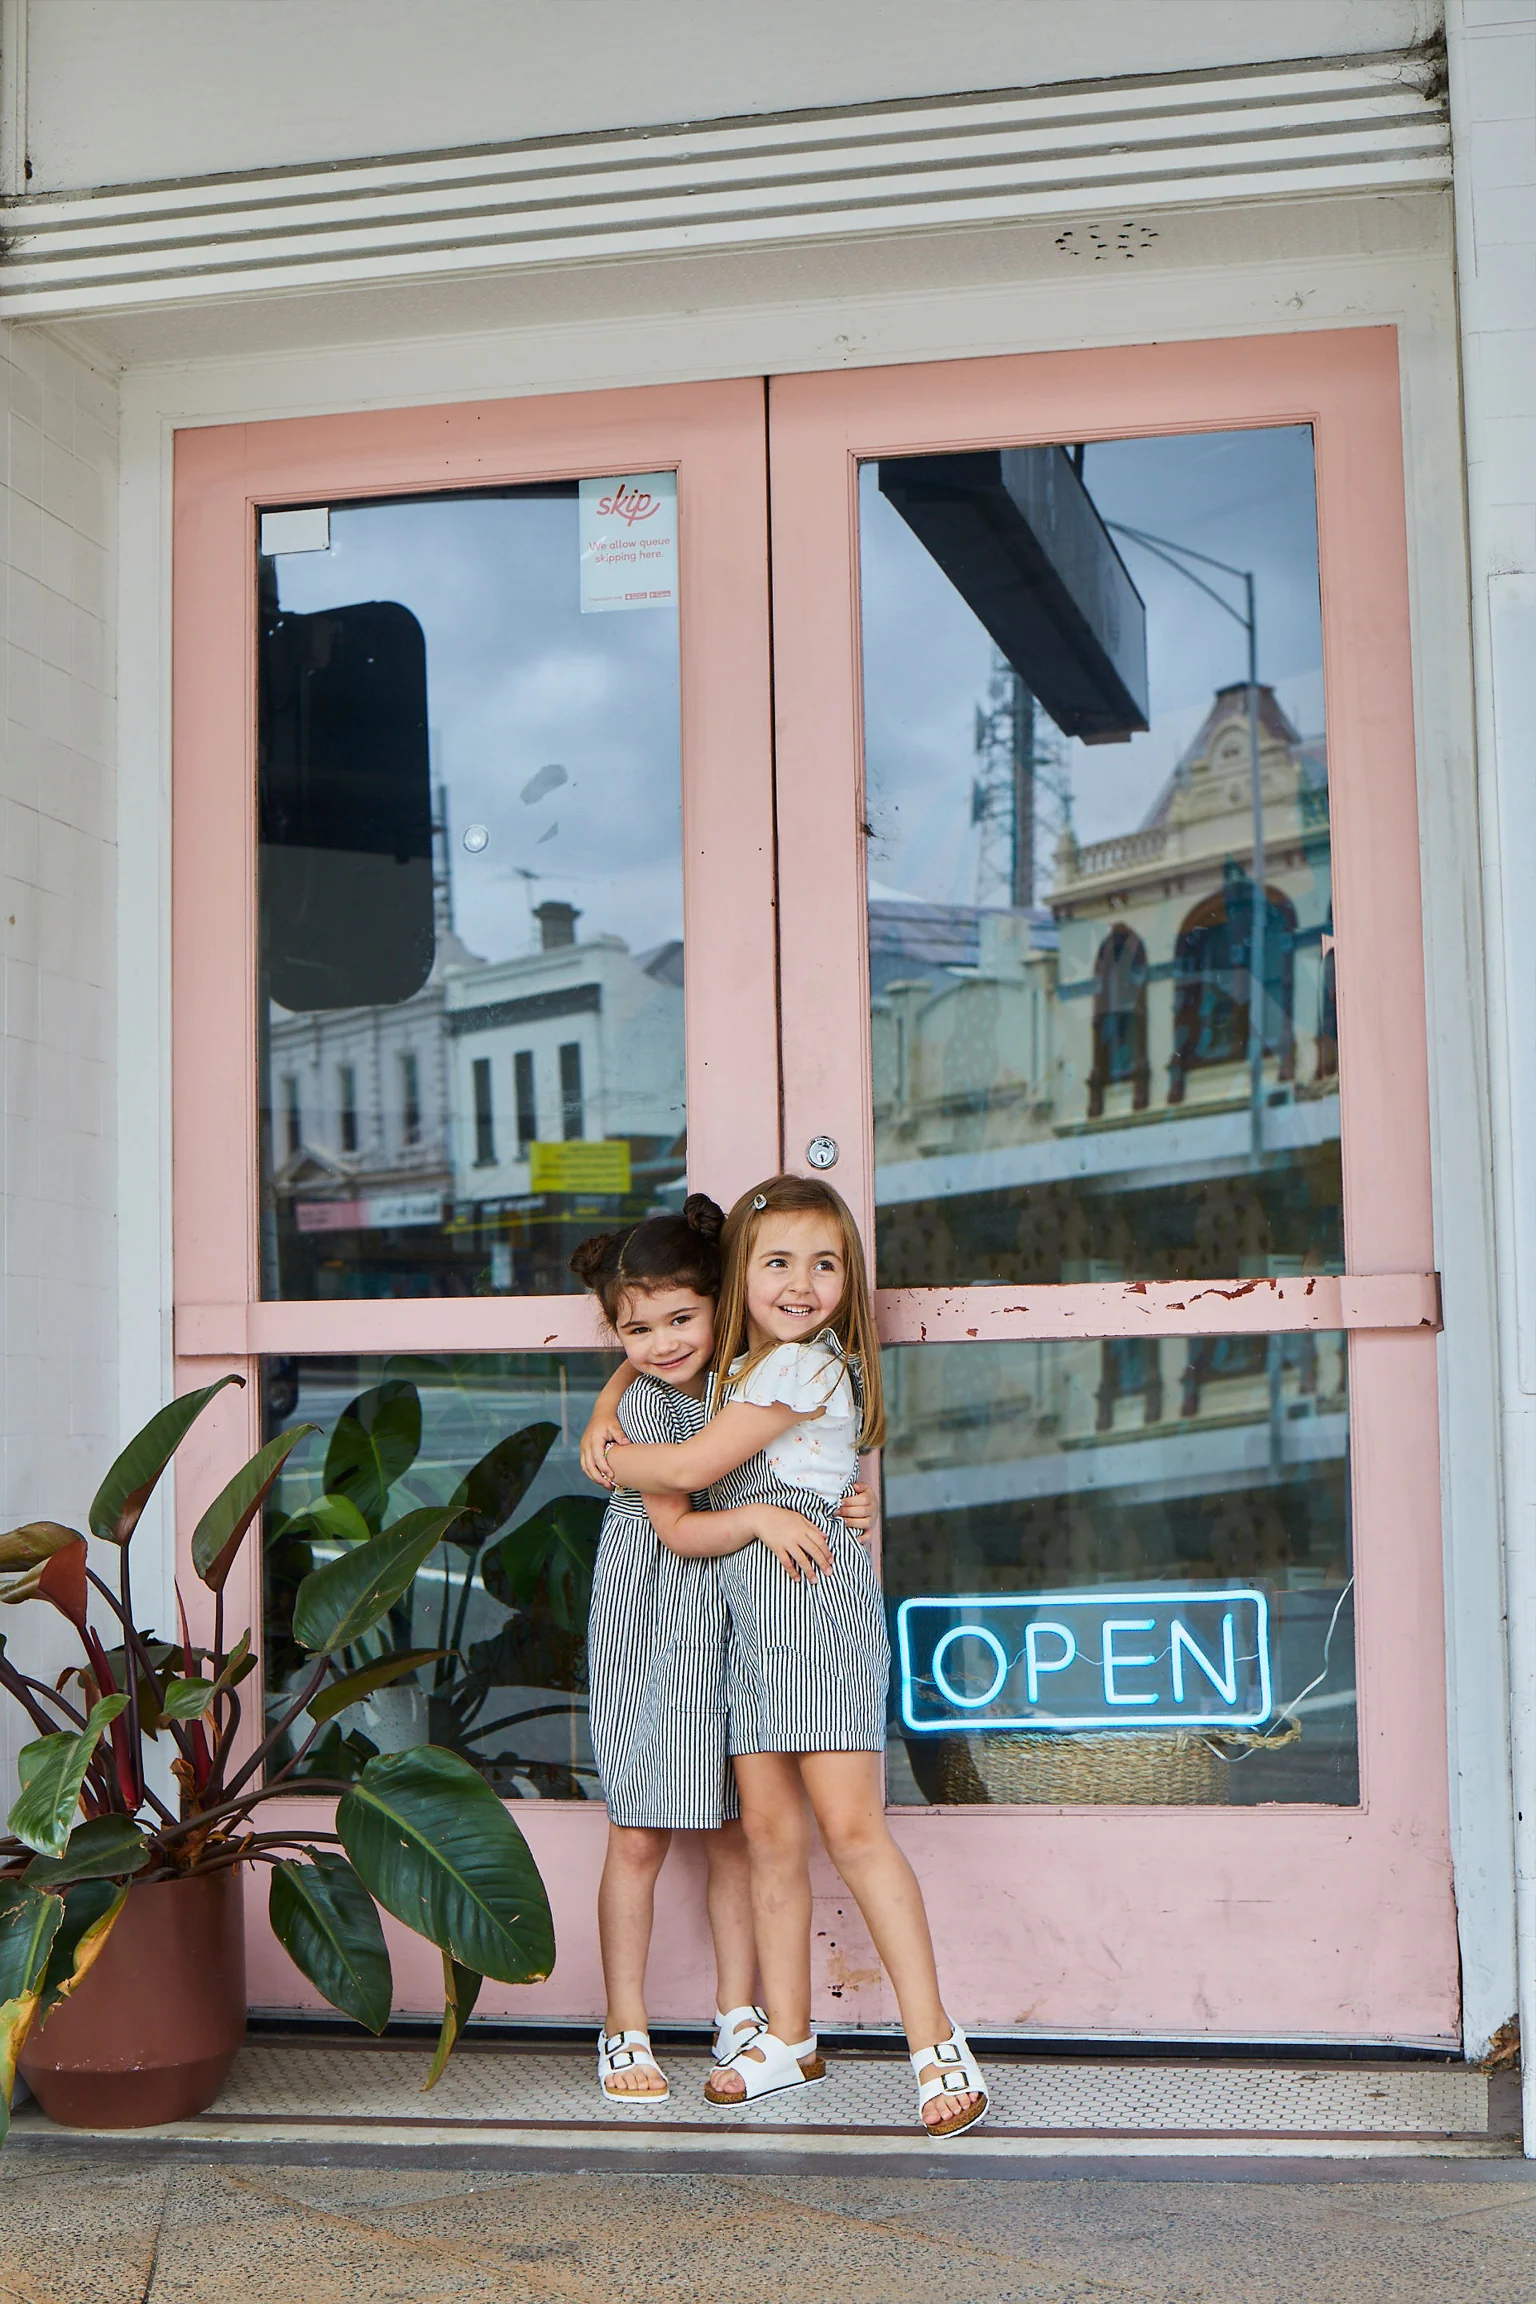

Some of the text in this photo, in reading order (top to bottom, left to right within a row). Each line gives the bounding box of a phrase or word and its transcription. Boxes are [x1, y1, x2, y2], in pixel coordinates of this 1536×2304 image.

[596, 484, 660, 527] skip
[589, 538, 670, 551] We allow queue
[595, 550, 664, 563] skipping here.
[932, 1612, 1237, 1709] OPEN
